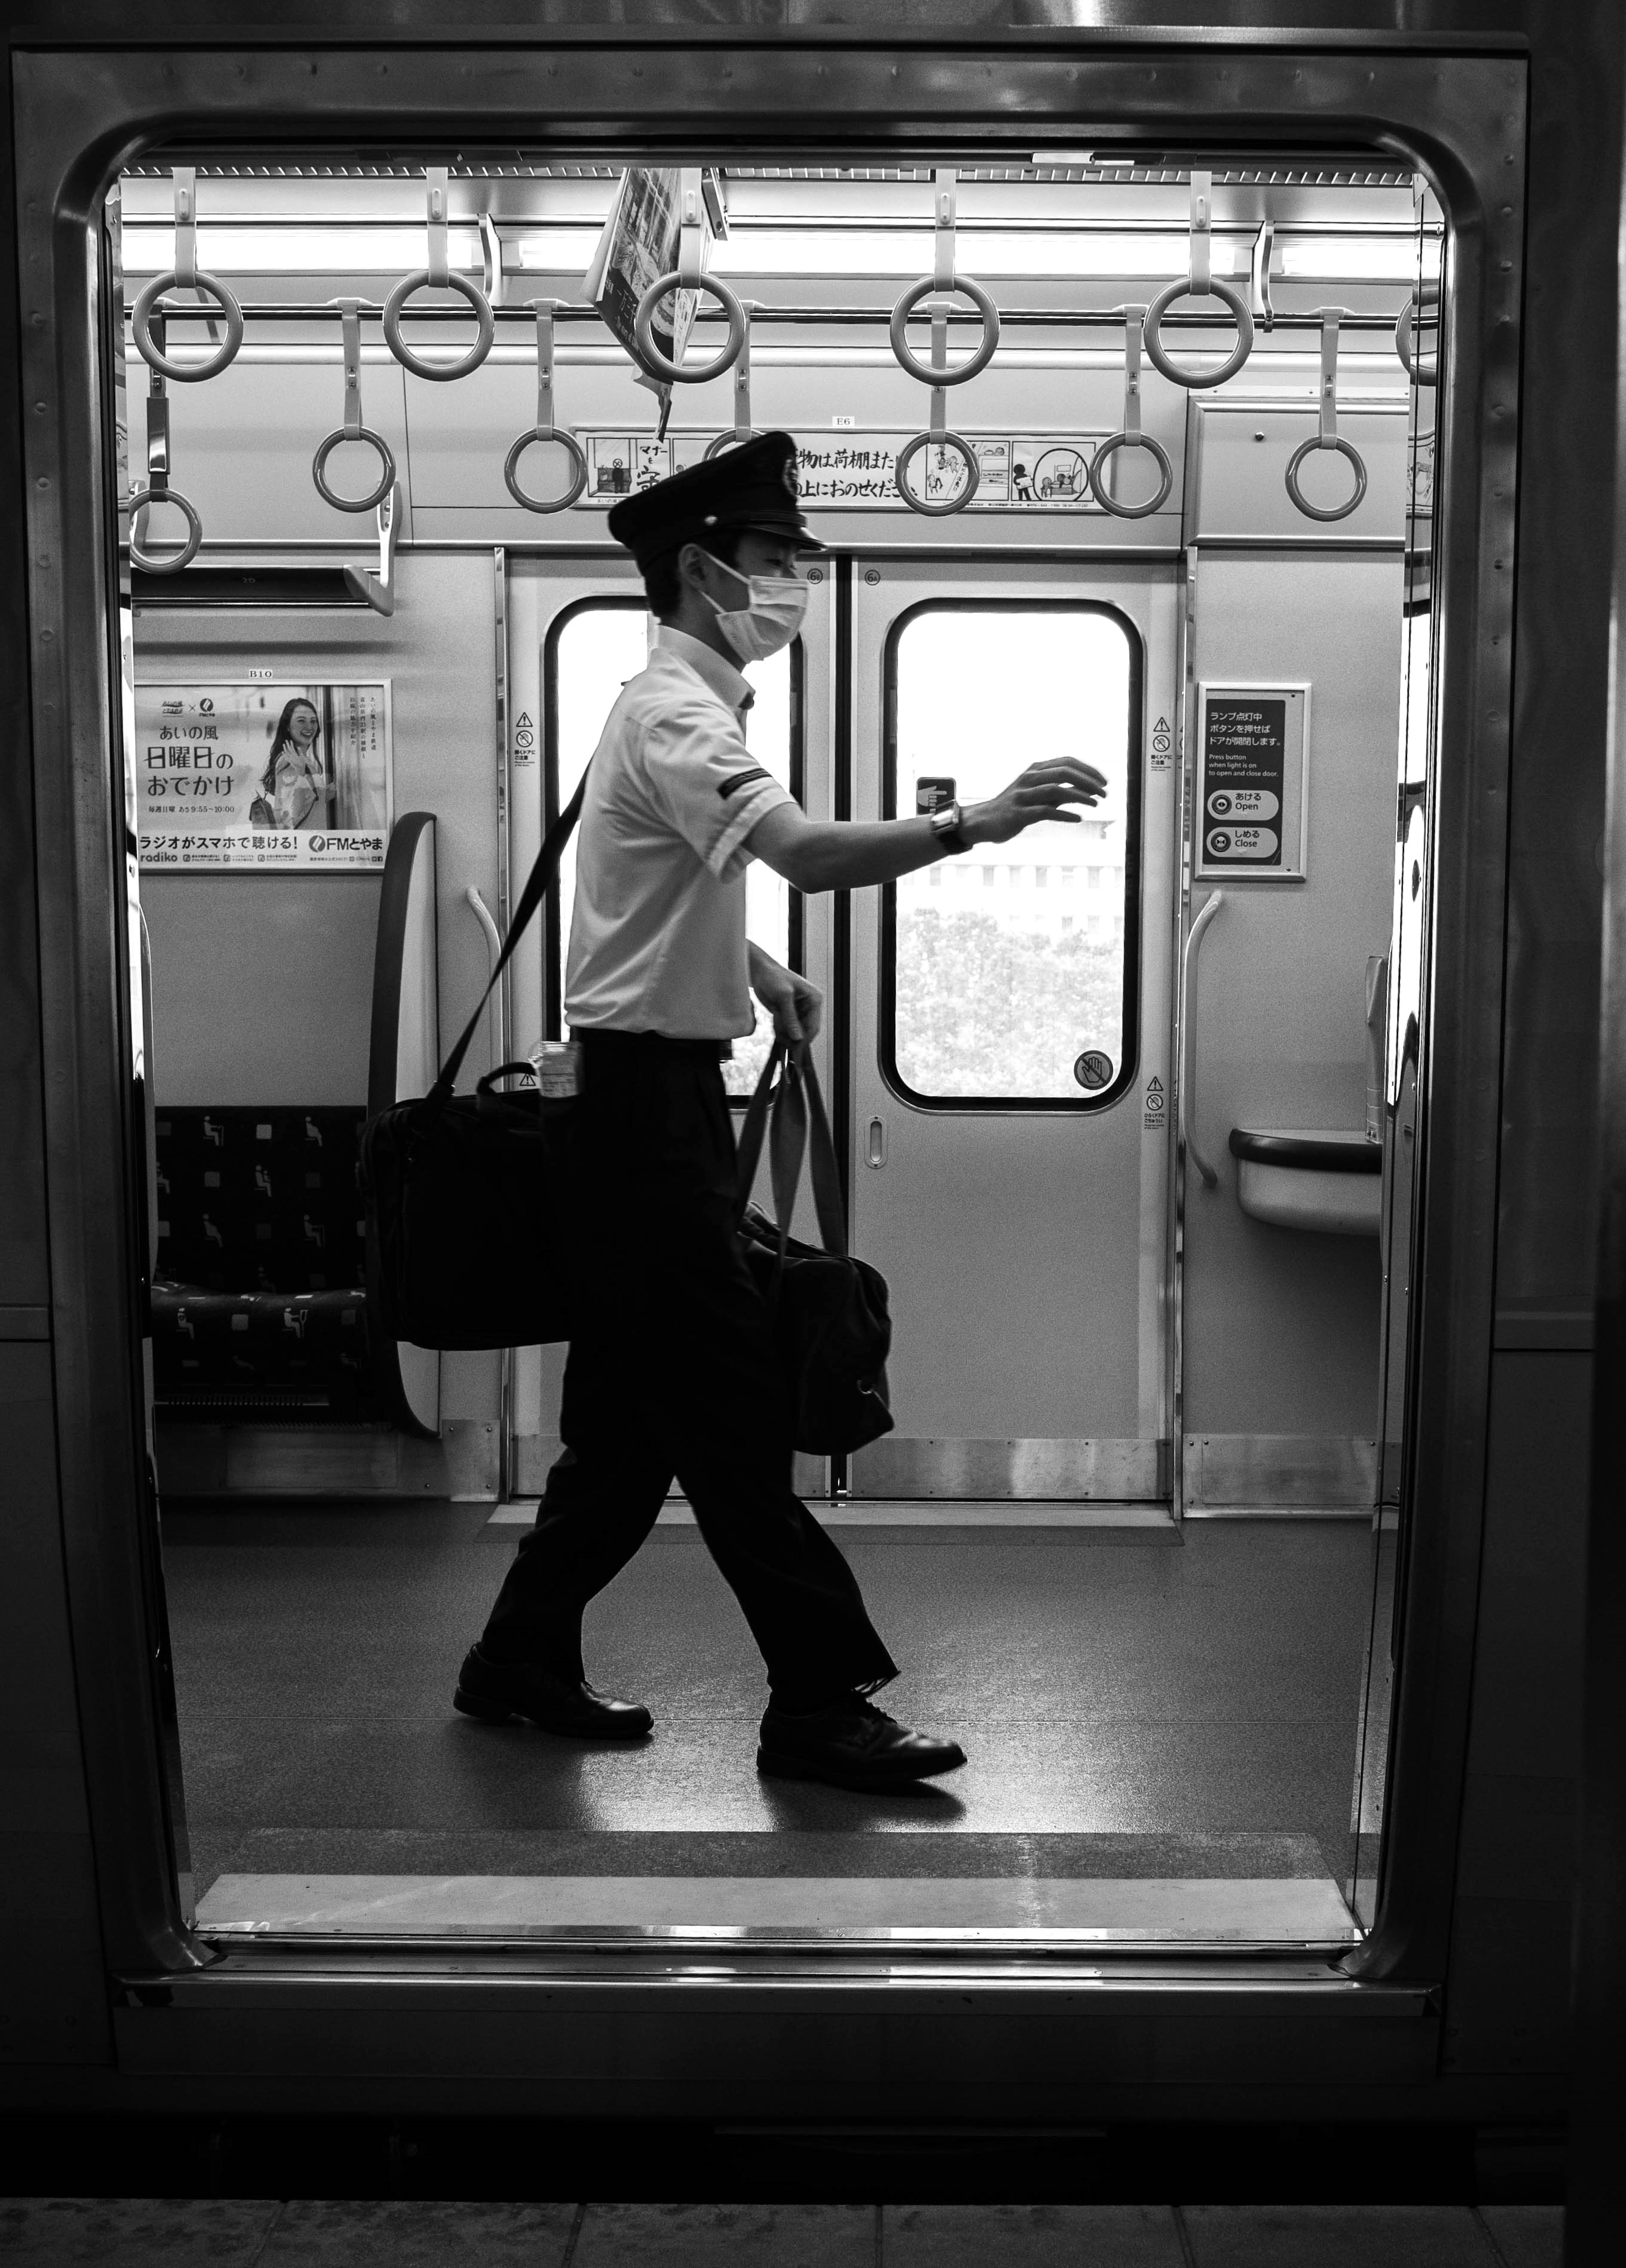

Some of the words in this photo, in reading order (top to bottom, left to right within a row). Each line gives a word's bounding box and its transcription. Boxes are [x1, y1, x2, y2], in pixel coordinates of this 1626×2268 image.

[640, 446, 668, 456] マナー
[795, 449, 910, 470] 物は荷棚また
[868, 573, 877, 582] 6A
[249, 670, 272, 678] B10
[1210, 712, 1262, 721] ランプ点灯中
[160, 726, 218, 740] あいの風
[1209, 725, 1271, 734] ボタンを押せば
[1209, 737, 1281, 746] ドアが開閉します。
[142, 747, 233, 769] 日曜日の
[148, 775, 235, 796] おでかけ
[1235, 793, 1261, 801] あける
[1235, 803, 1258, 811] Open
[1235, 830, 1259, 838] しめる
[326, 838, 383, 850] FMとやま
[140, 852, 178, 862] radiko
